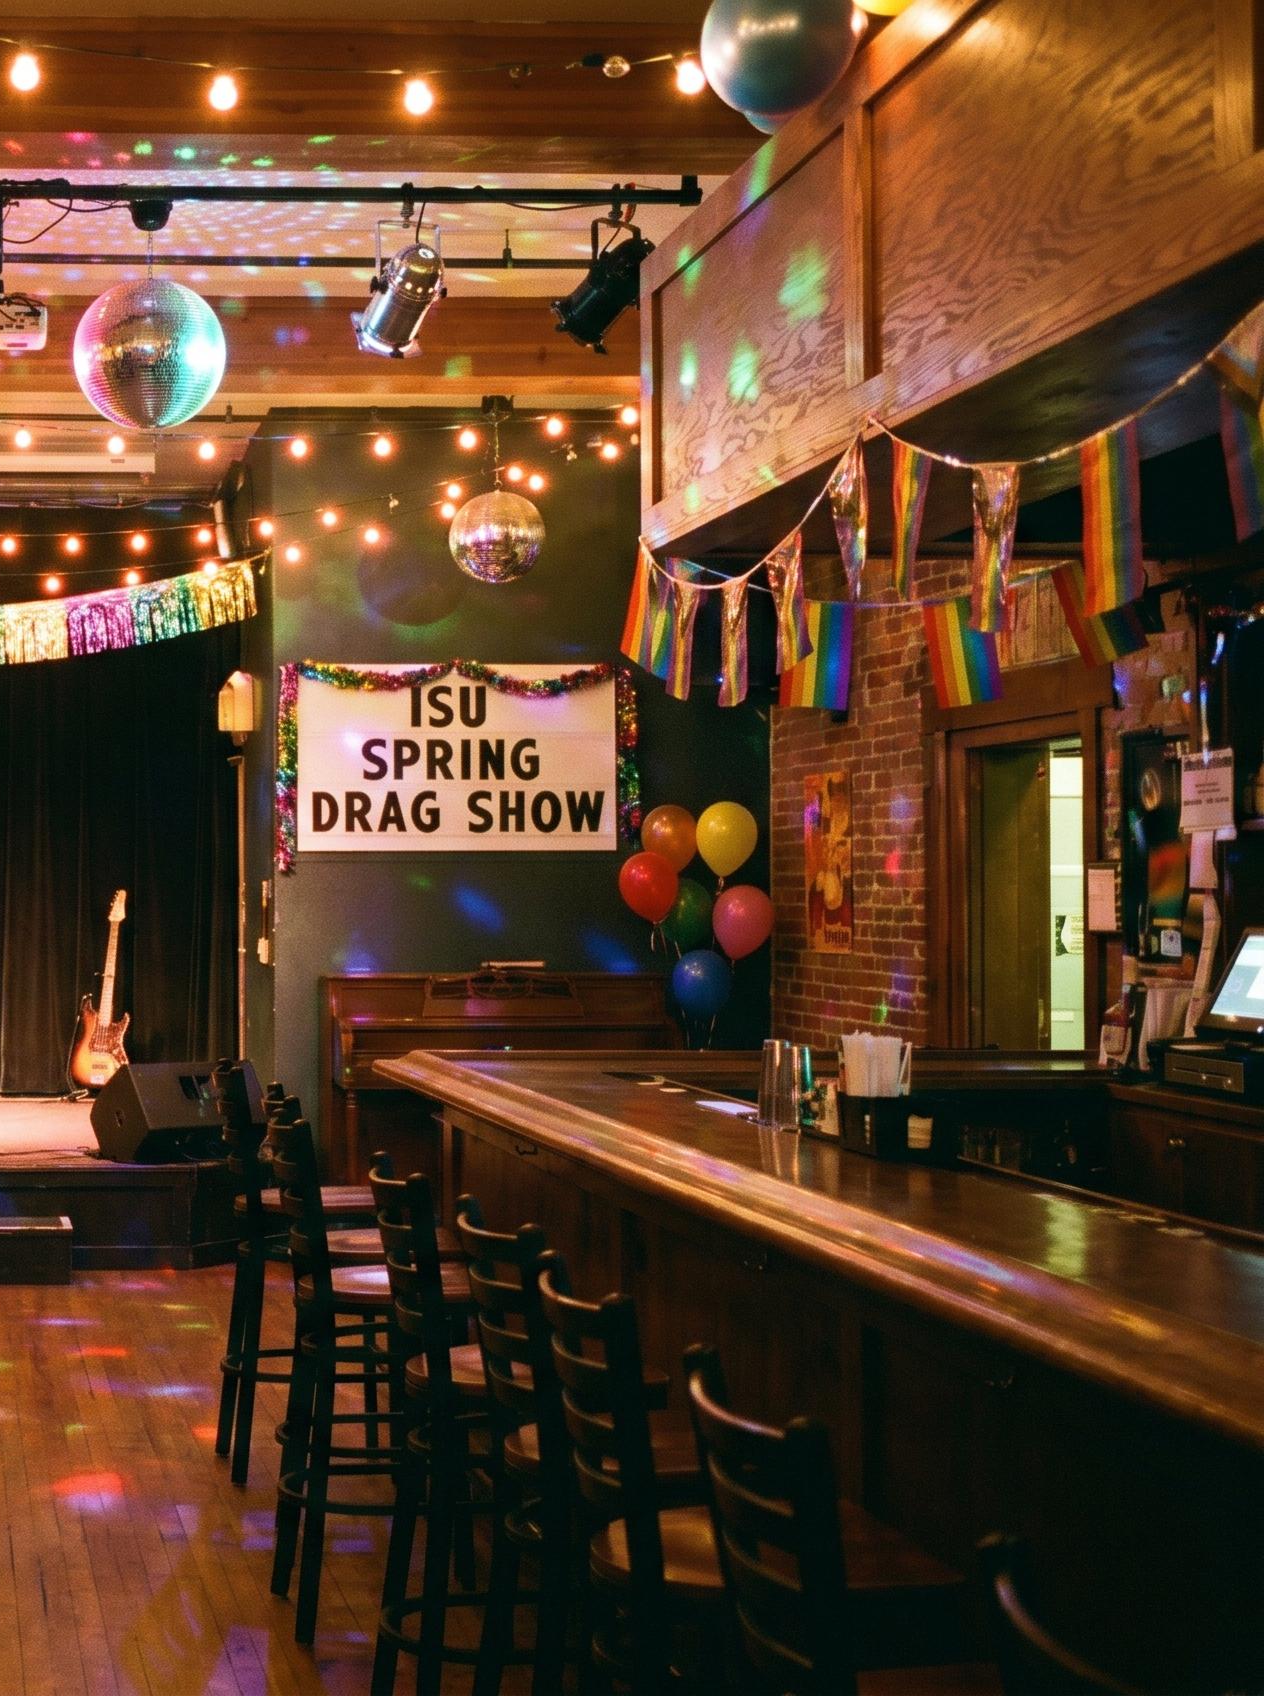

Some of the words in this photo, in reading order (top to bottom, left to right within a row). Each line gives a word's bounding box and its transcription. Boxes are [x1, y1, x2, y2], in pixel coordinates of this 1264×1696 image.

[411, 685, 487, 728] ISU
[361, 738, 540, 781] SPRING
[312, 790, 441, 833] DRAG
[467, 790, 606, 833] SHOW
